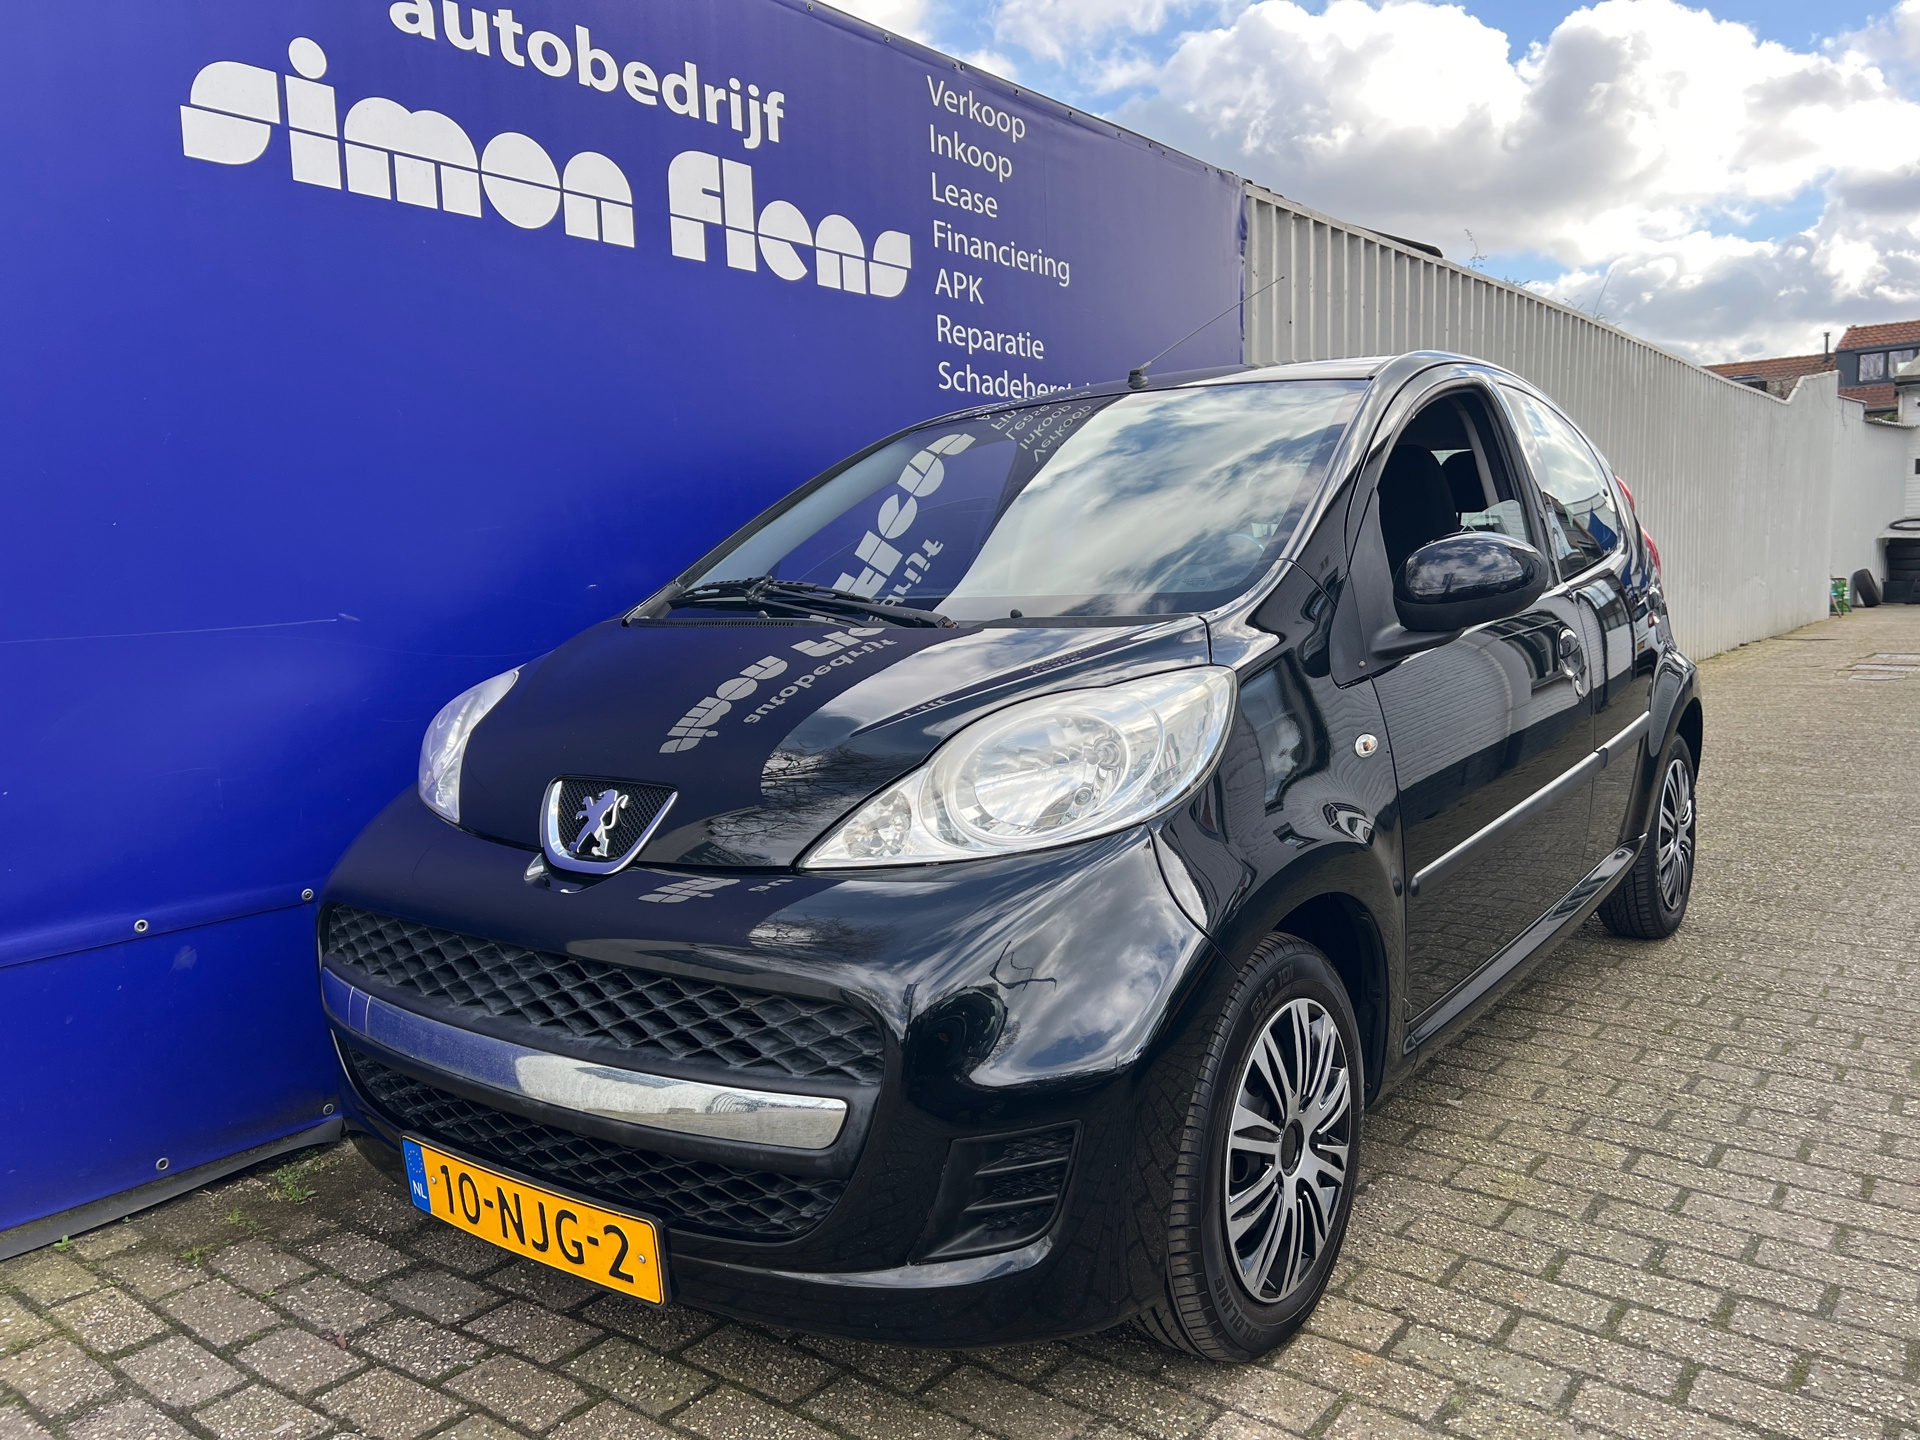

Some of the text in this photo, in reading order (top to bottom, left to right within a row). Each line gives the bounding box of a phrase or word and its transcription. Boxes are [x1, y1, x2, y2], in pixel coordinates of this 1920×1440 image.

[389, 0, 785, 149] autobedrijf
[926, 74, 1026, 143] Verkoop
[180, 37, 912, 298] simon flens
[929, 124, 1013, 182] Inkoop
[931, 172, 998, 218] Lease
[933, 219, 1071, 288] Financiering
[934, 268, 985, 305] APK
[936, 313, 1045, 360] Reparatie
[412, 1179, 428, 1200] NL
[440, 1164, 635, 1284] 10-NJG-2
